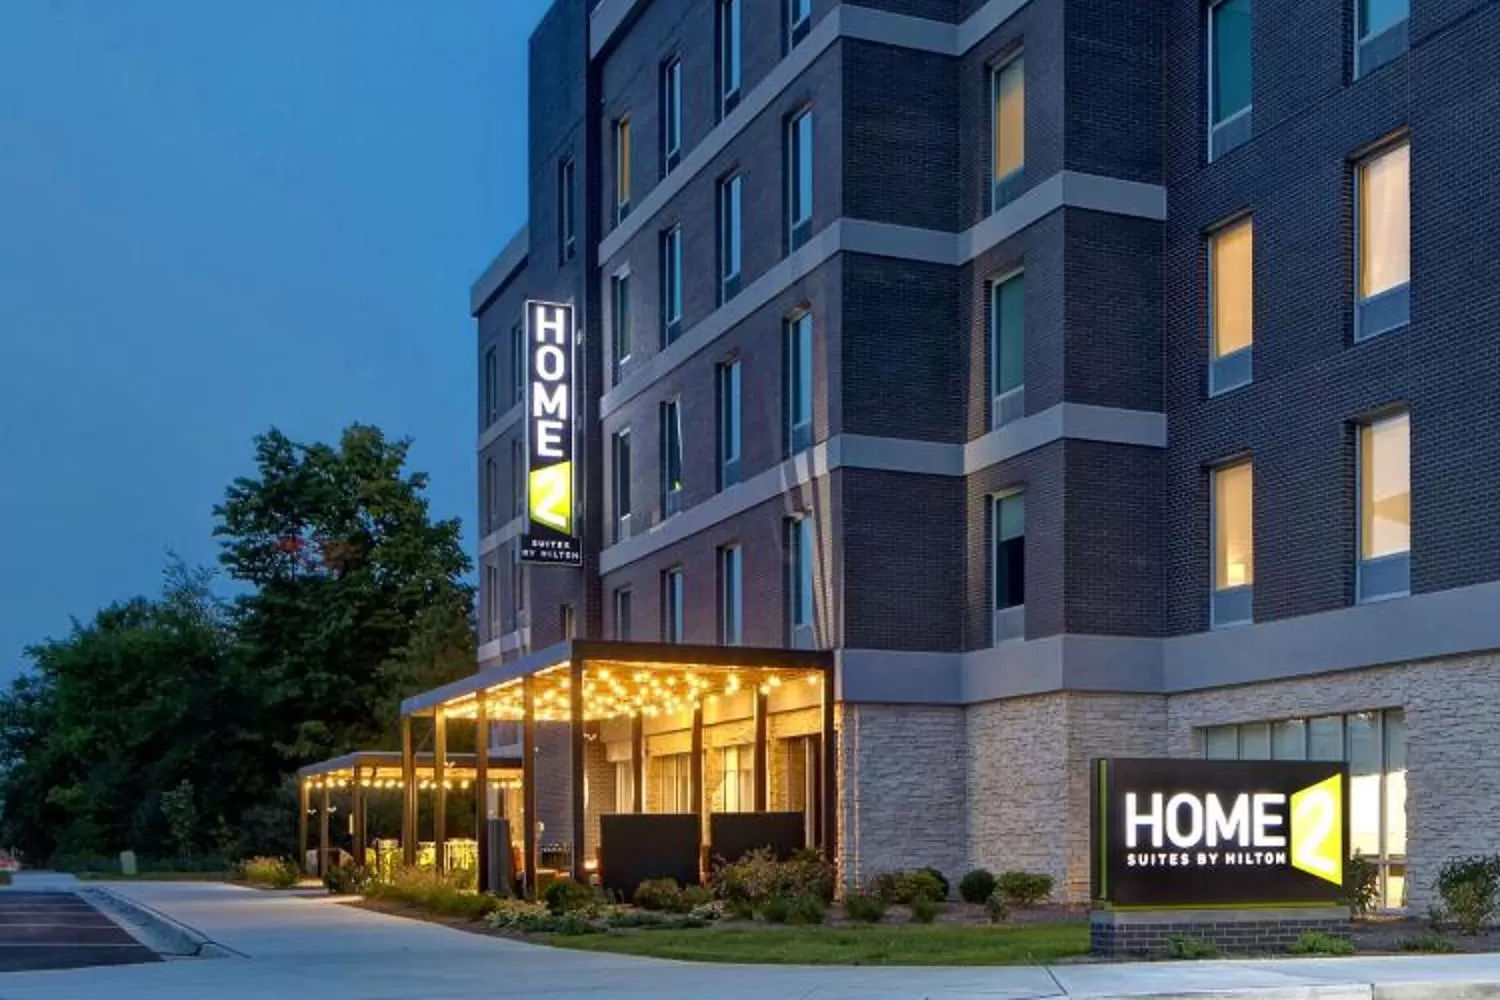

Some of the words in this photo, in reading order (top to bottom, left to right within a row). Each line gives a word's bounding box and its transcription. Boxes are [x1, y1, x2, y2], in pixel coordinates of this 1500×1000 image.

[533, 306, 567, 457] HOME
[535, 468, 567, 528] 2
[1125, 792, 1287, 848] HOME
[1295, 789, 1336, 875] 2
[1126, 852, 1190, 866] SUITES
[1196, 852, 1219, 865] BY
[1225, 851, 1287, 865] HILTON
